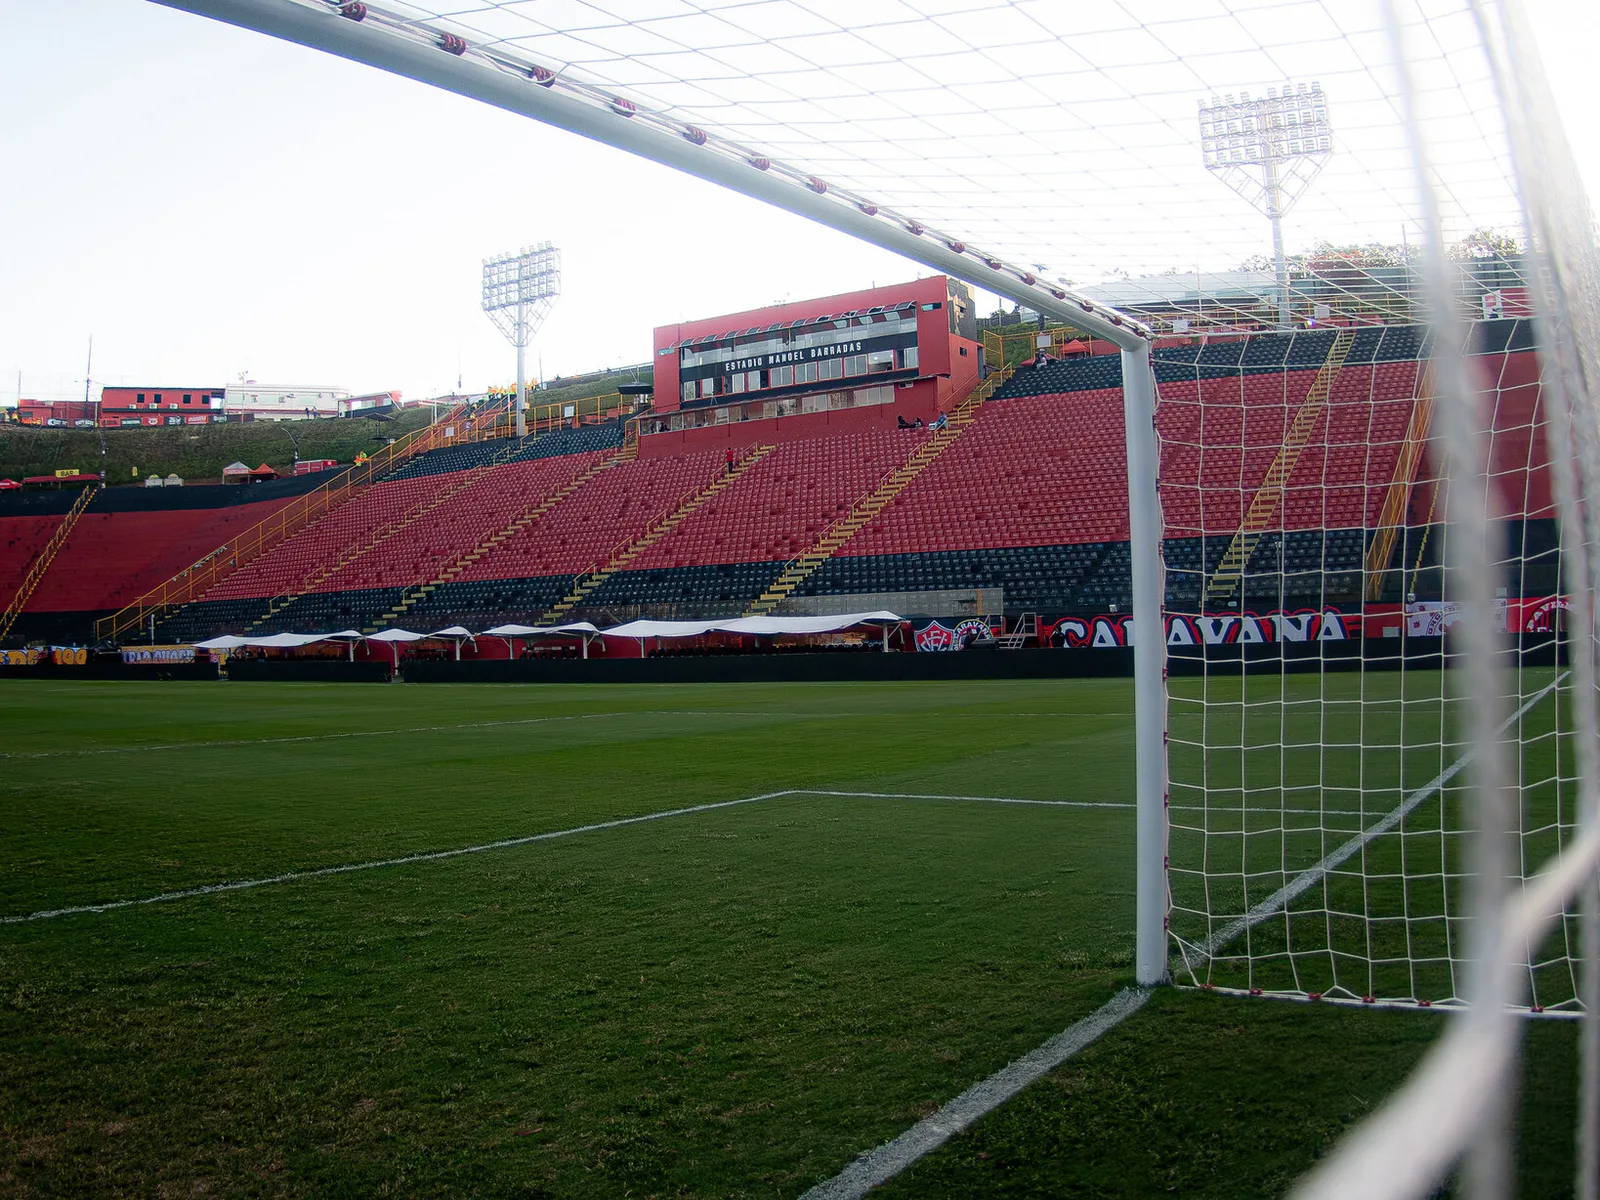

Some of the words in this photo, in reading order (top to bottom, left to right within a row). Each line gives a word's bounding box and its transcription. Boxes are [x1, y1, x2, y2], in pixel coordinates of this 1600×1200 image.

[725, 358, 763, 372] ESTADIO
[768, 350, 805, 364] MANOEL
[810, 342, 862, 358] BARRADAS
[1058, 610, 1349, 648] CAAVANA
